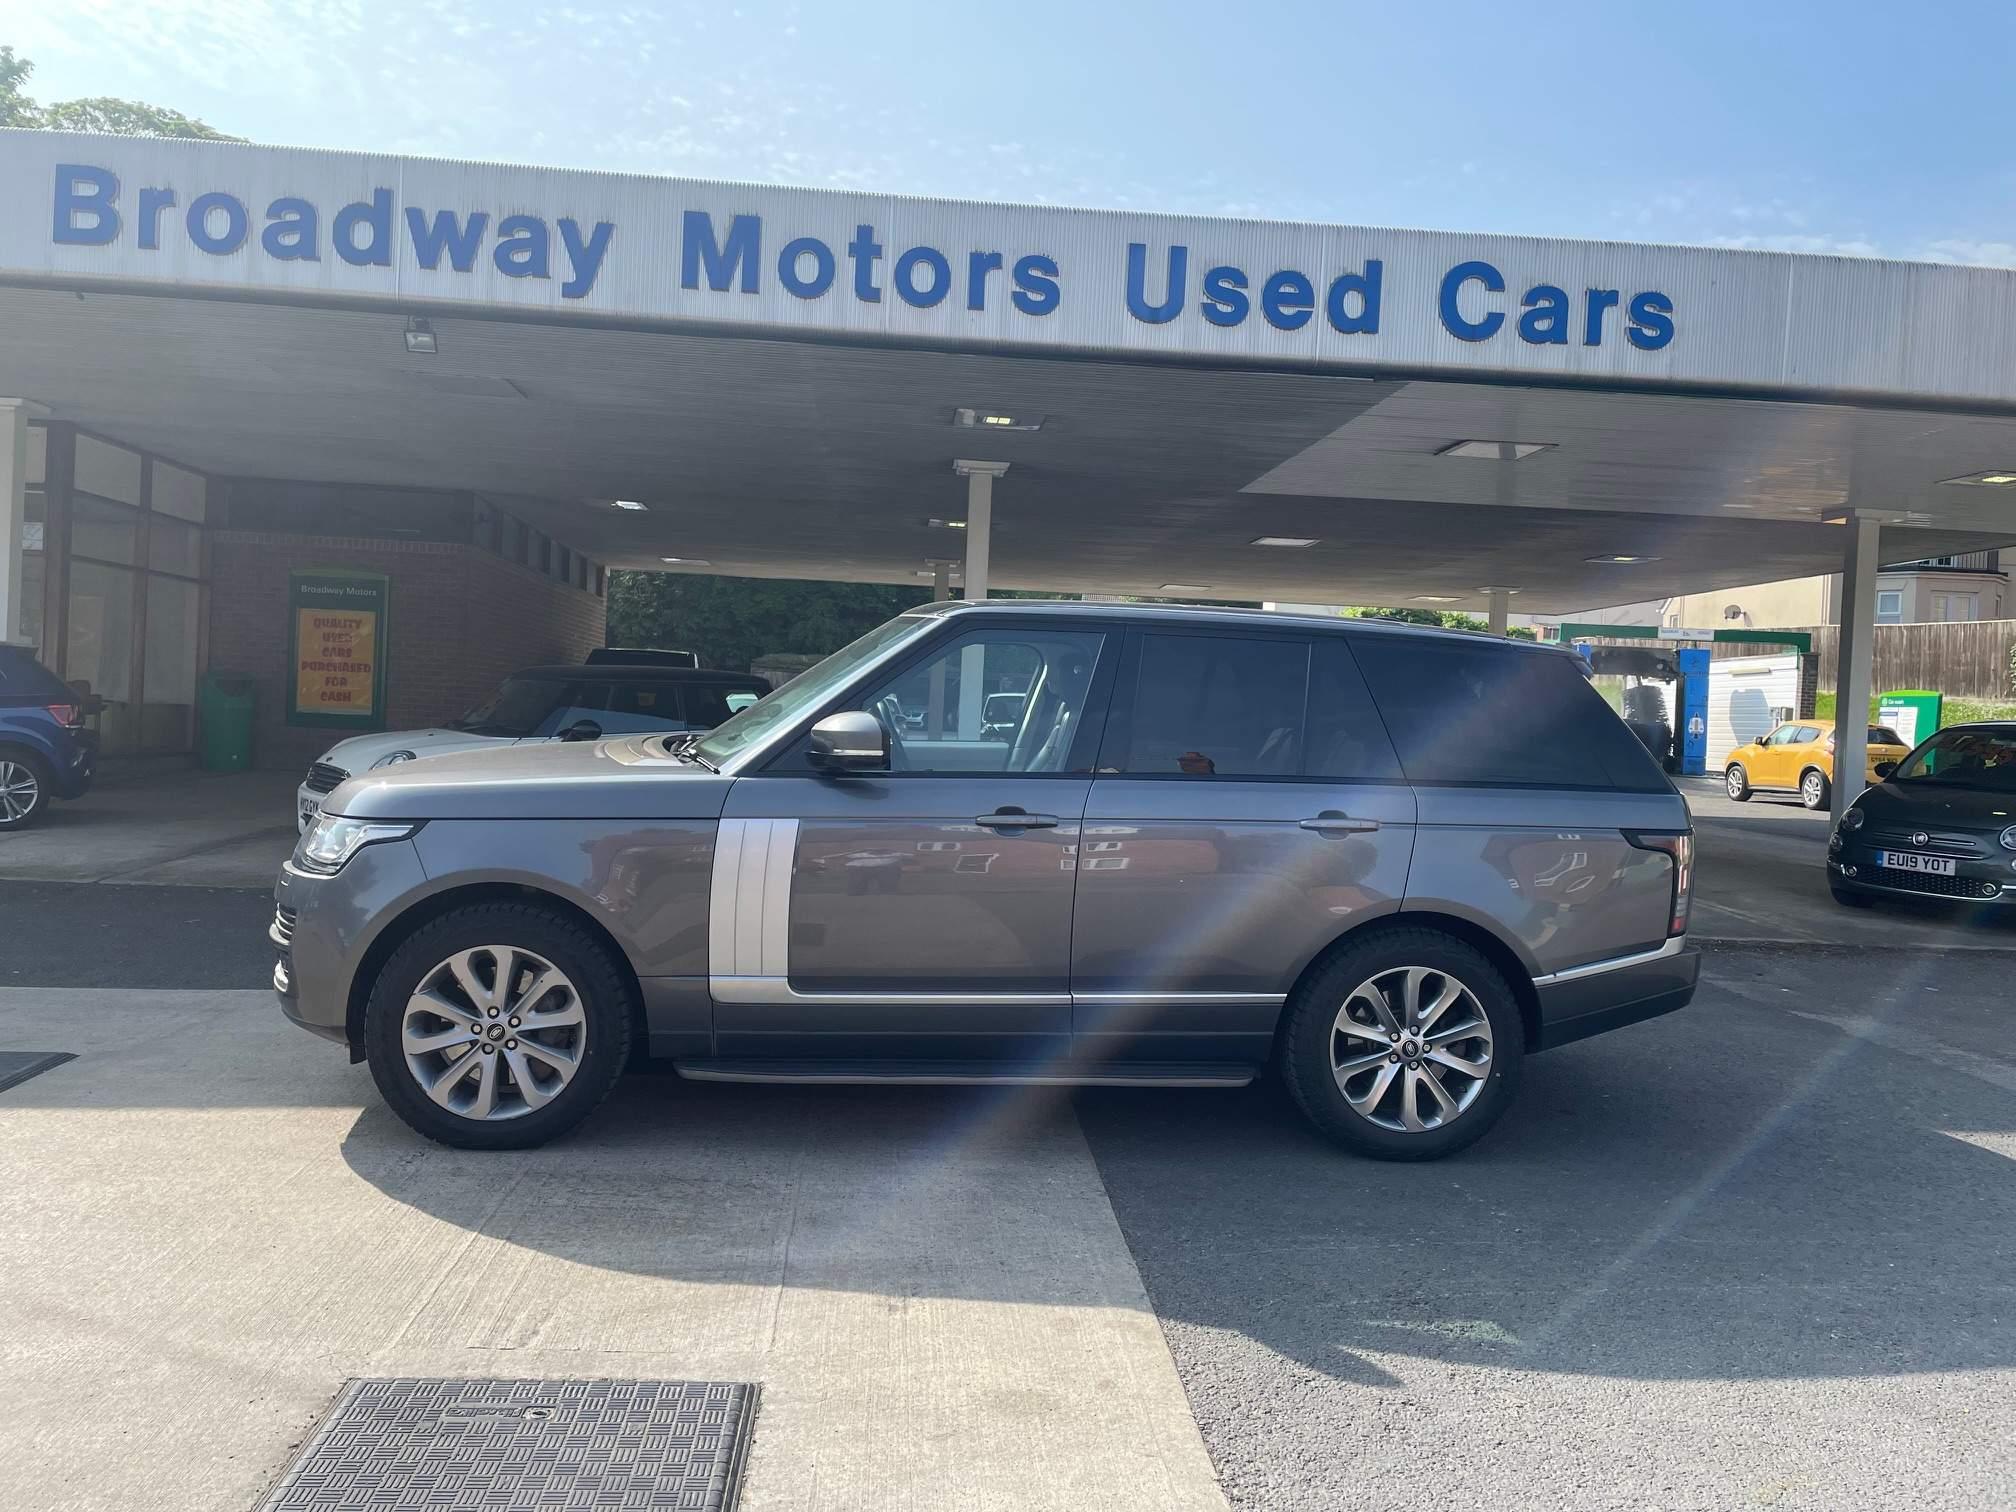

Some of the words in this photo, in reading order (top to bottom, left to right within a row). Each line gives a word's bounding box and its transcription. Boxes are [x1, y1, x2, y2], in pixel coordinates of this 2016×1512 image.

[52, 163, 617, 299] Broadway
[681, 210, 1062, 316] Motors
[1126, 242, 1384, 335] Used
[1438, 260, 1675, 351] Cars
[301, 585, 343, 596] Broadway
[346, 587, 377, 596] Motors
[313, 618, 363, 629] QUALITY
[322, 633, 353, 643] USED
[322, 647, 353, 658] CARS
[301, 662, 371, 673] PURCHASED
[325, 677, 348, 687] FOR
[320, 692, 351, 702] CASH
[1887, 853, 1918, 868] EU19
[1922, 857, 1950, 872] YOT
